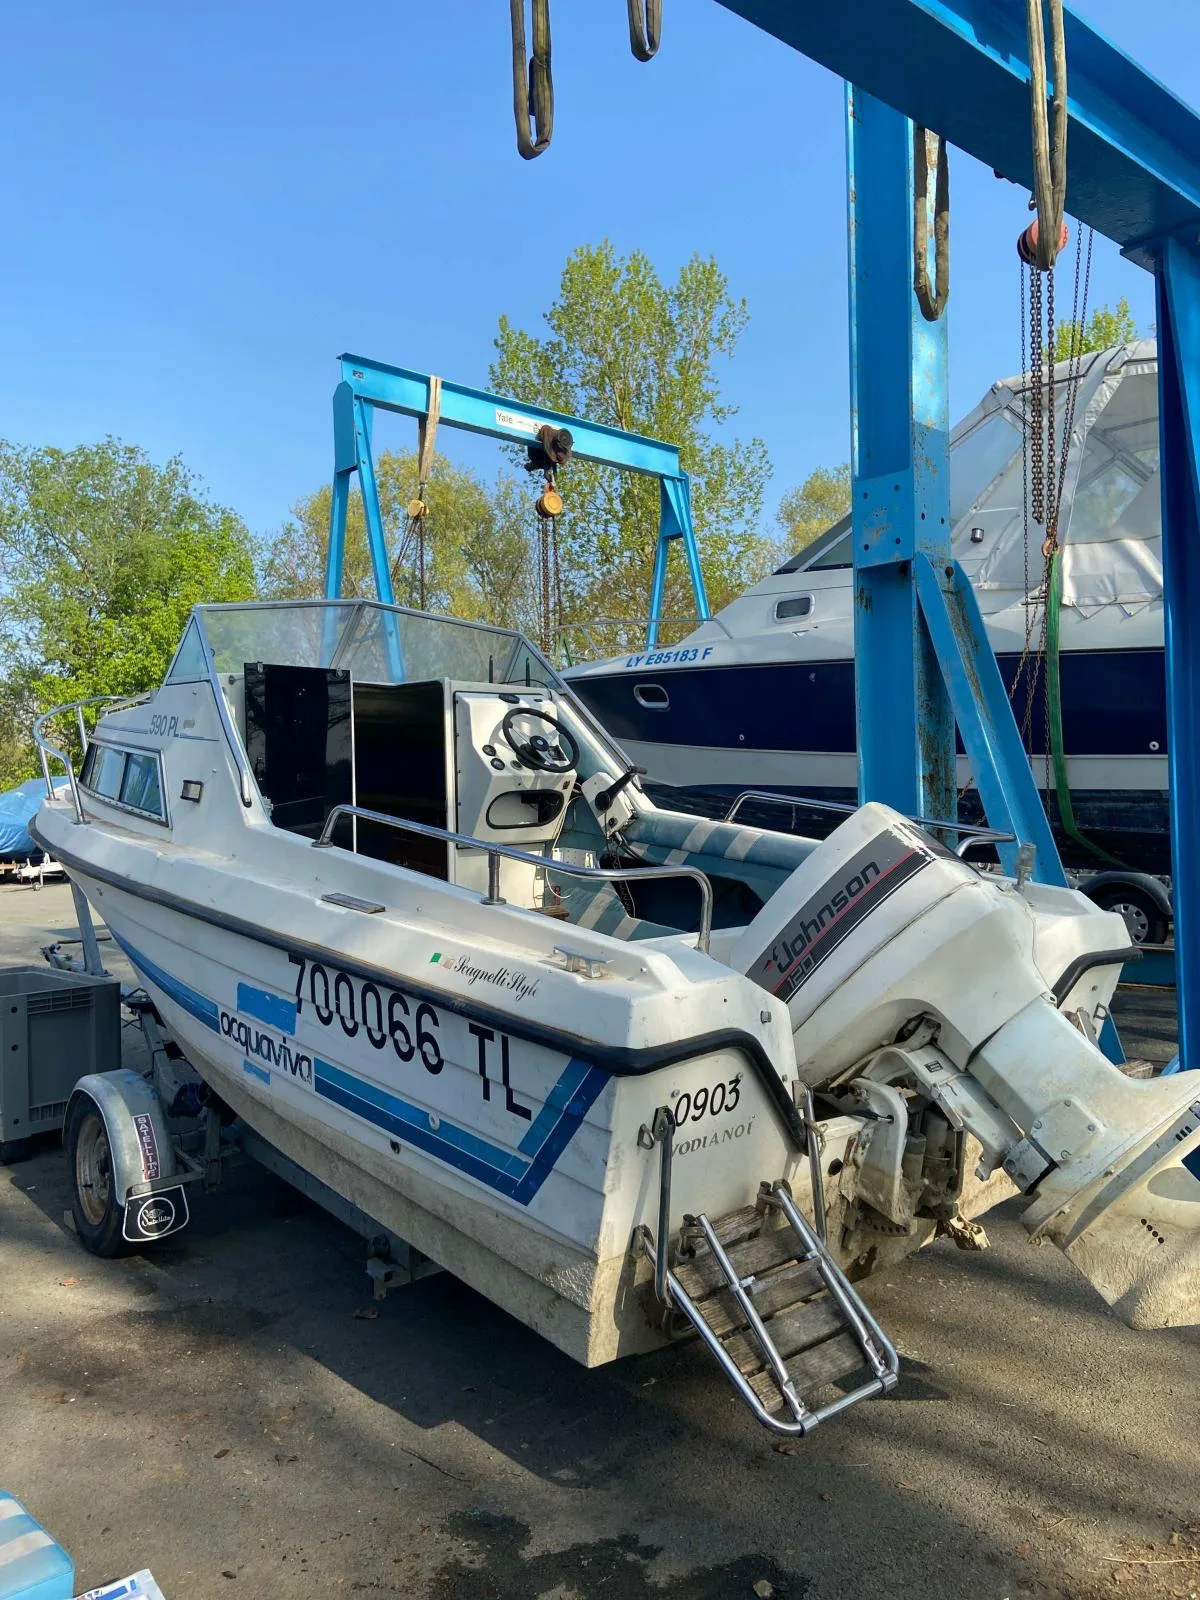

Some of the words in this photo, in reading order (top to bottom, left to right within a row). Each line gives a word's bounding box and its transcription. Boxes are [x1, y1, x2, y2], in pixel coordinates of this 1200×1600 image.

[497, 411, 513, 424] Yale
[626, 655, 644, 668] LY
[645, 648, 699, 666] E85183
[702, 647, 713, 660] F
[149, 714, 168, 736] 590
[167, 716, 179, 737] PL
[776, 861, 881, 974] Johnson
[454, 955, 509, 985] Scagnelli
[220, 1011, 313, 1086] acquaviva
[288, 953, 445, 1075] 700066
[469, 1022, 532, 1121] TL
[137, 1117, 158, 1178] SATELLITE
